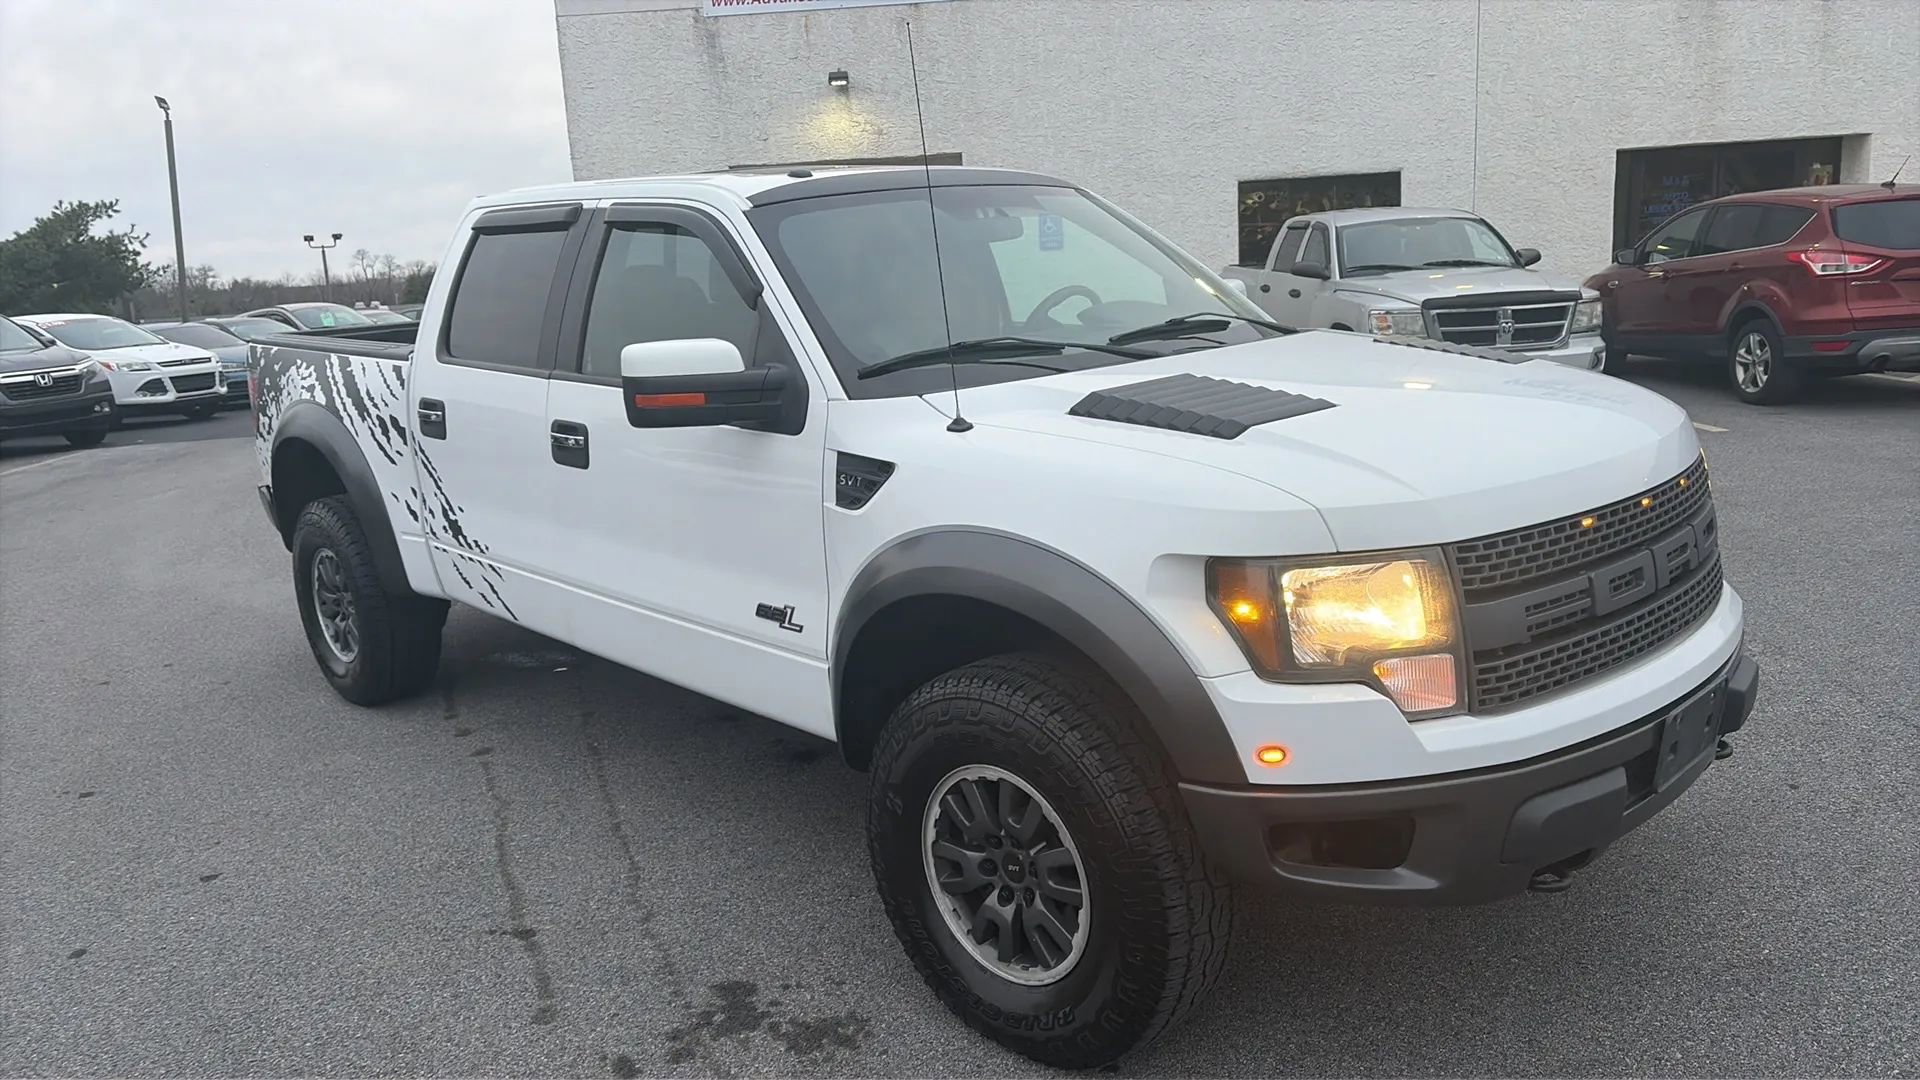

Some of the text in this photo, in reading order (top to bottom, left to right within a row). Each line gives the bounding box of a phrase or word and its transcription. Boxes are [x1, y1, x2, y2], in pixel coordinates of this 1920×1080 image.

[839, 473, 862, 488] SVT
[1465, 508, 1718, 651] FORD
[1007, 864, 1020, 872] SVT
